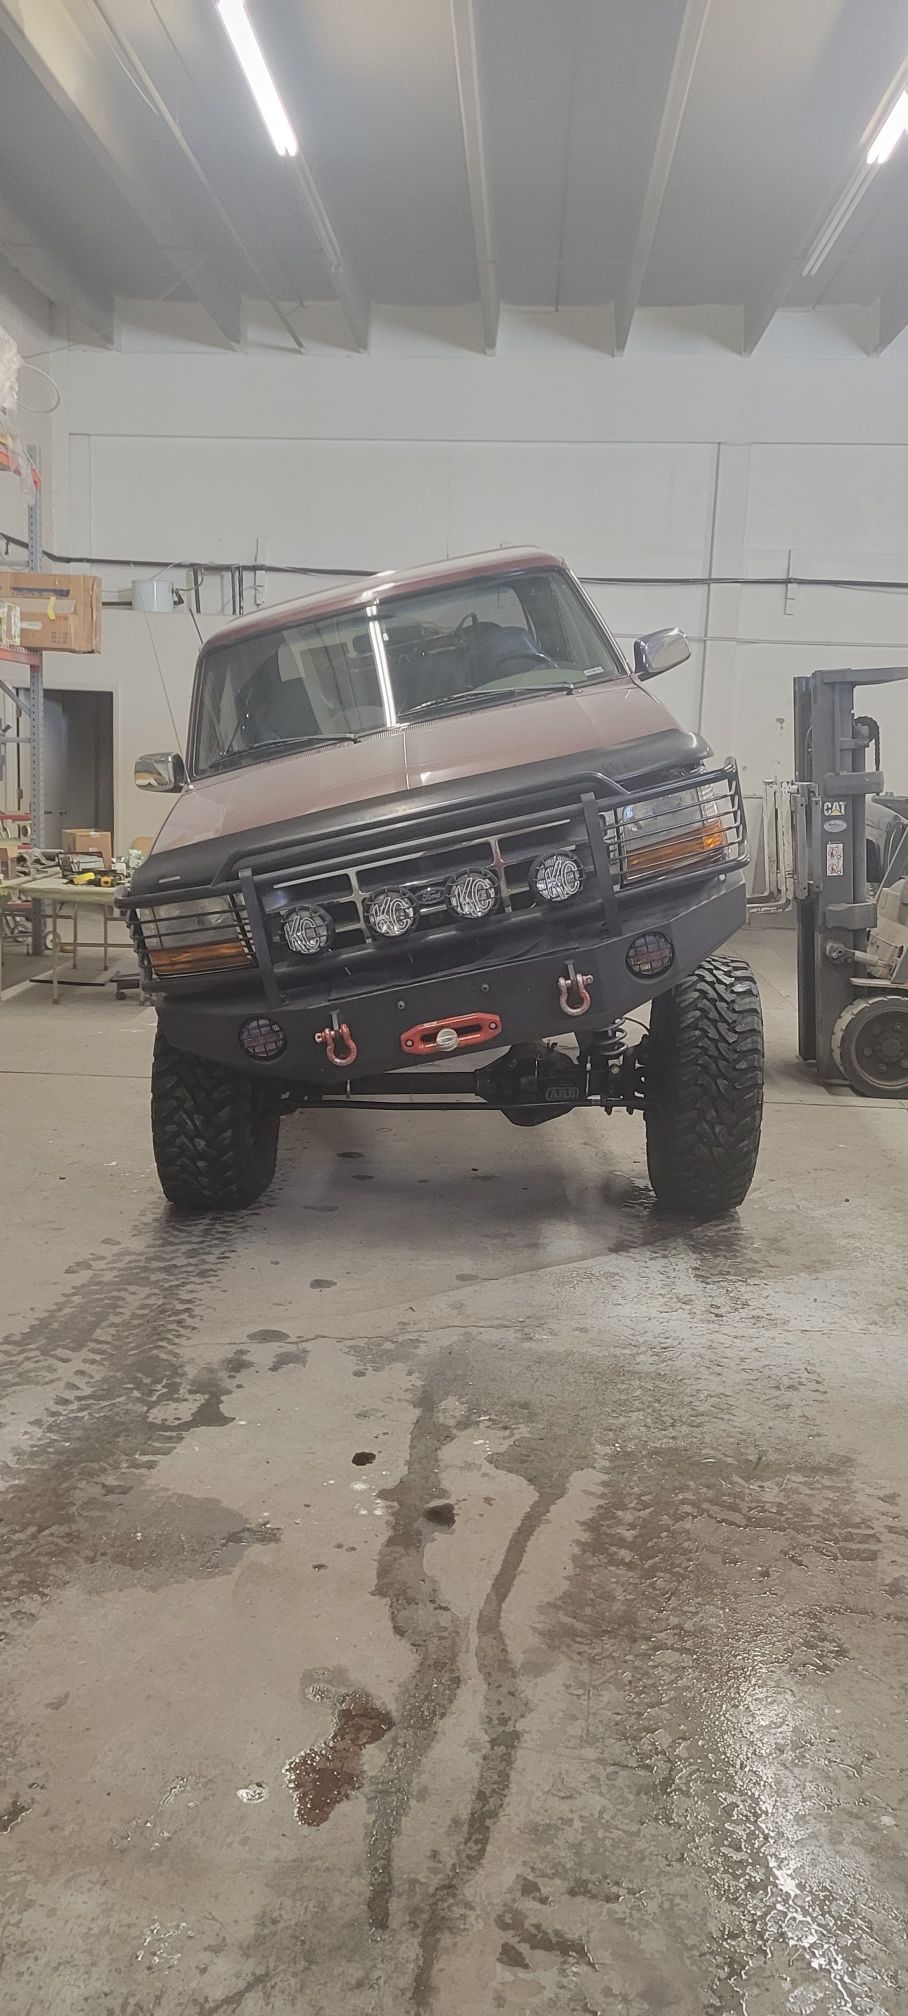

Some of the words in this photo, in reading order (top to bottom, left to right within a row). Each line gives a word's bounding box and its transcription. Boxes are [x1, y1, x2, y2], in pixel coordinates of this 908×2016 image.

[824, 801, 847, 816] CAT
[421, 890, 442, 901] Ford
[455, 877, 492, 917] KC
[544, 860, 580, 900] KC
[284, 916, 320, 954] KC
[372, 897, 411, 936] KC
